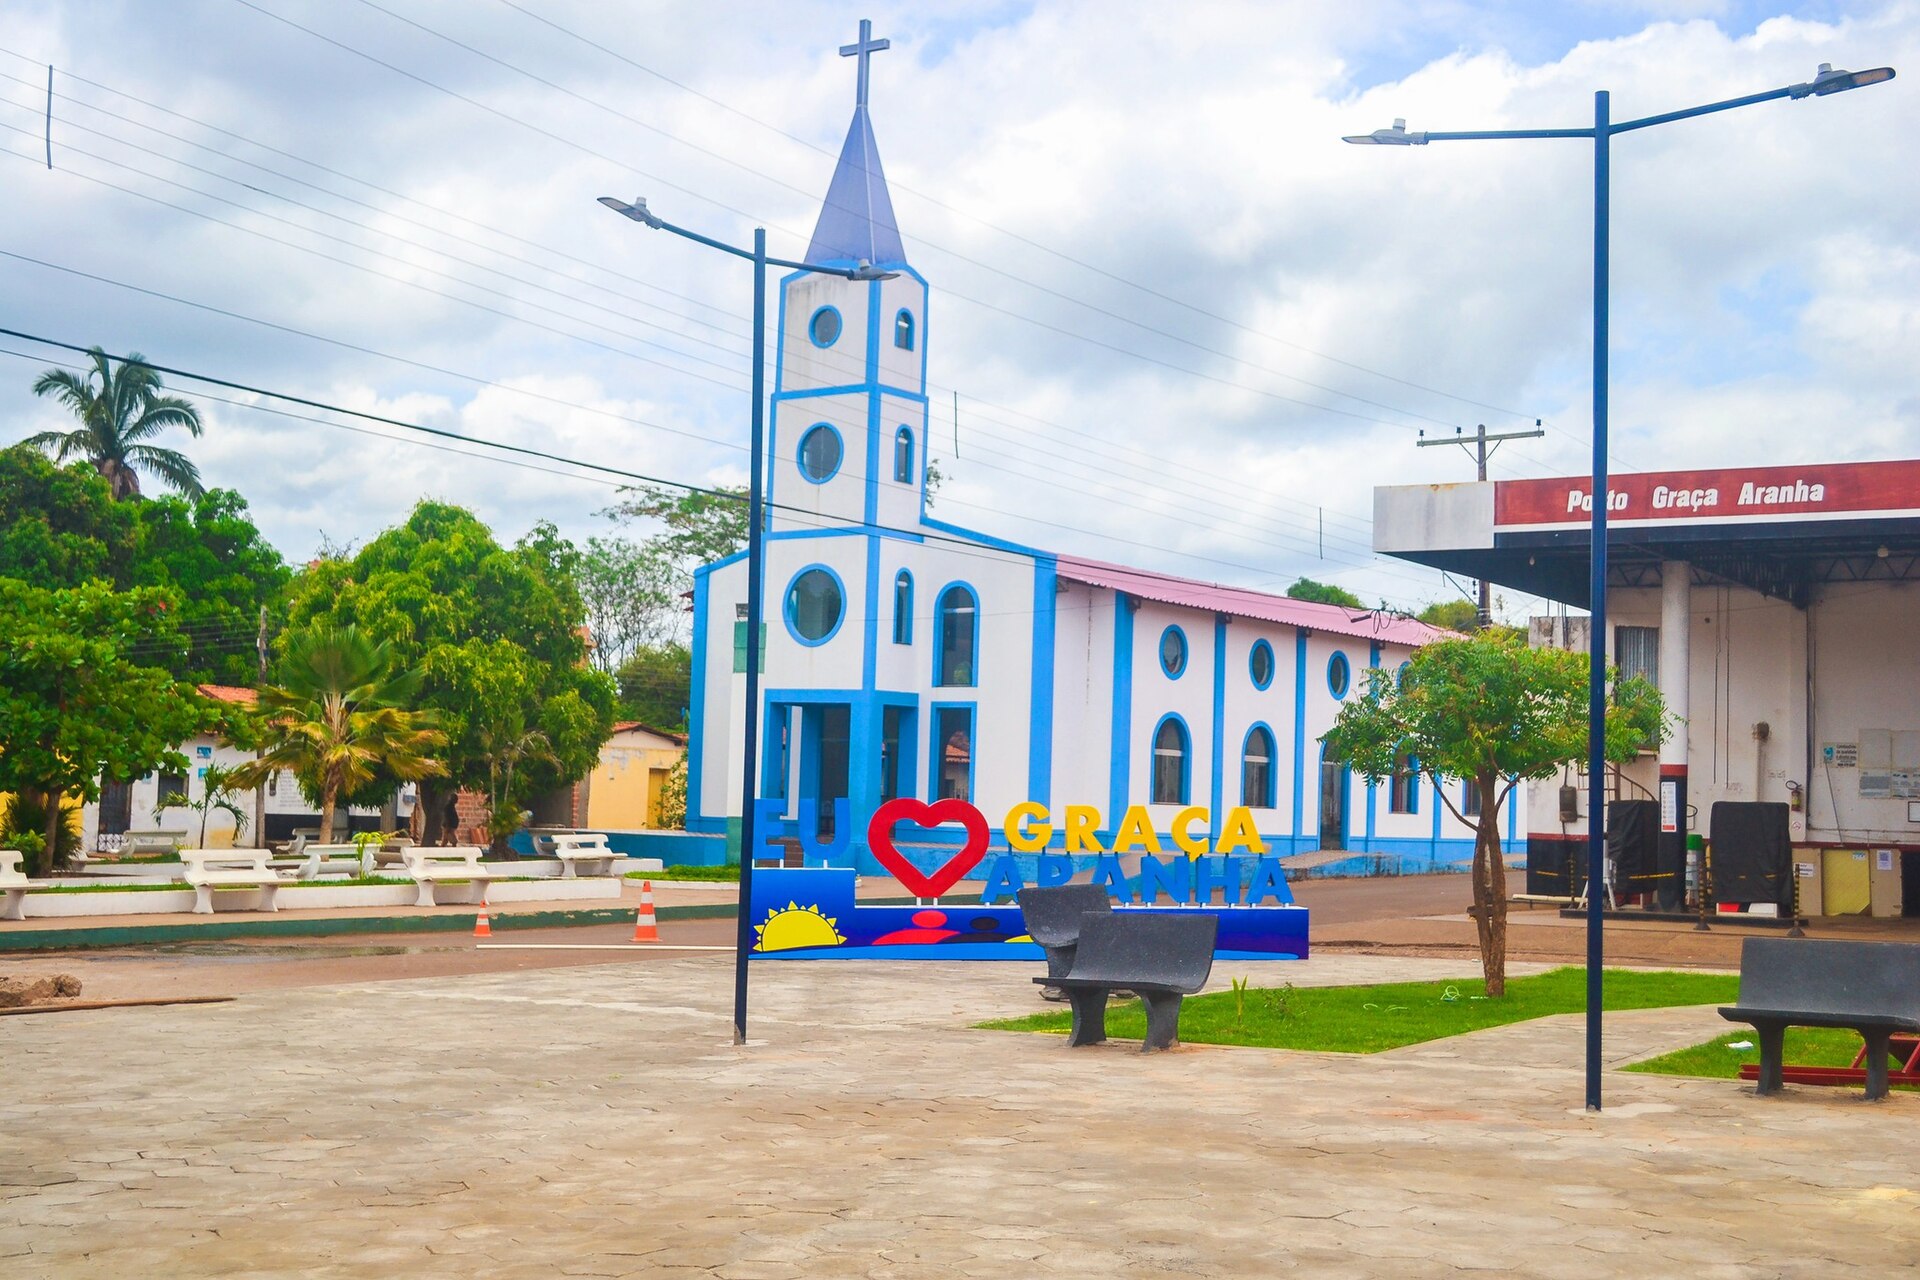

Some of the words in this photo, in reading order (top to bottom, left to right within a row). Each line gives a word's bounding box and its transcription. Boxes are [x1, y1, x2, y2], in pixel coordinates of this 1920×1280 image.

[1567, 490, 1629, 513] Poto
[1652, 486, 1718, 512] Graça
[1737, 480, 1825, 505] Aranha
[753, 797, 850, 860] EU
[1004, 801, 1265, 863] GRAÇA
